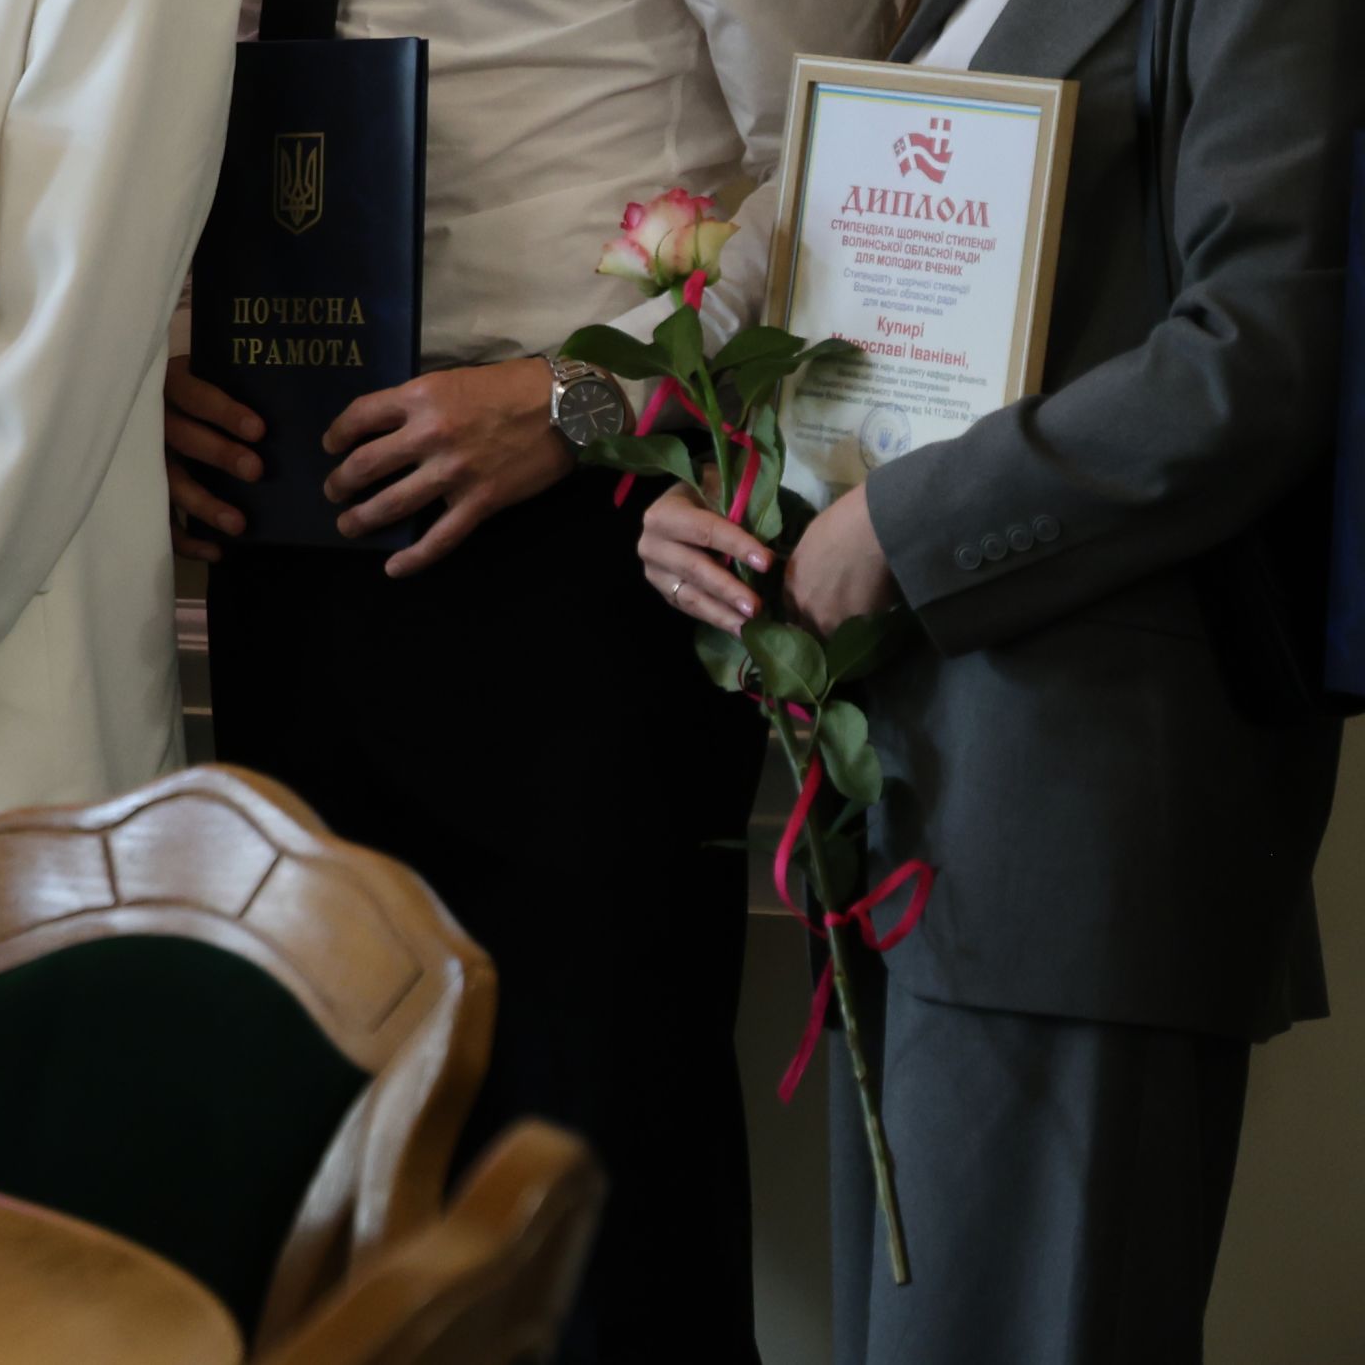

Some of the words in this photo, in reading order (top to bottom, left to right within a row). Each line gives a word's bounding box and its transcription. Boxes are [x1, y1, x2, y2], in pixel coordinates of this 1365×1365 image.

[841, 185, 990, 228] ДИПЛОМ
[830, 219, 895, 237] СТИПЕНДІАТА
[897, 227, 944, 242] ЩОРІЧНОЇ
[945, 234, 997, 251] СТИПЕНДІЇ
[841, 235, 903, 254] ВОЛИНСЬКОЇ
[904, 243, 953, 260] ОБЛАСНОЇ
[954, 250, 981, 265] РАДИ
[854, 252, 876, 265] ДЛЯ
[876, 255, 923, 271] МОЛОДИХ
[925, 261, 963, 277] ВЧЕНИХ
[233, 296, 366, 325] ПОЧЕСНА
[876, 315, 925, 340] Купирі
[232, 338, 364, 366] ГРАМОТА
[910, 343, 969, 370] Іванівні,
